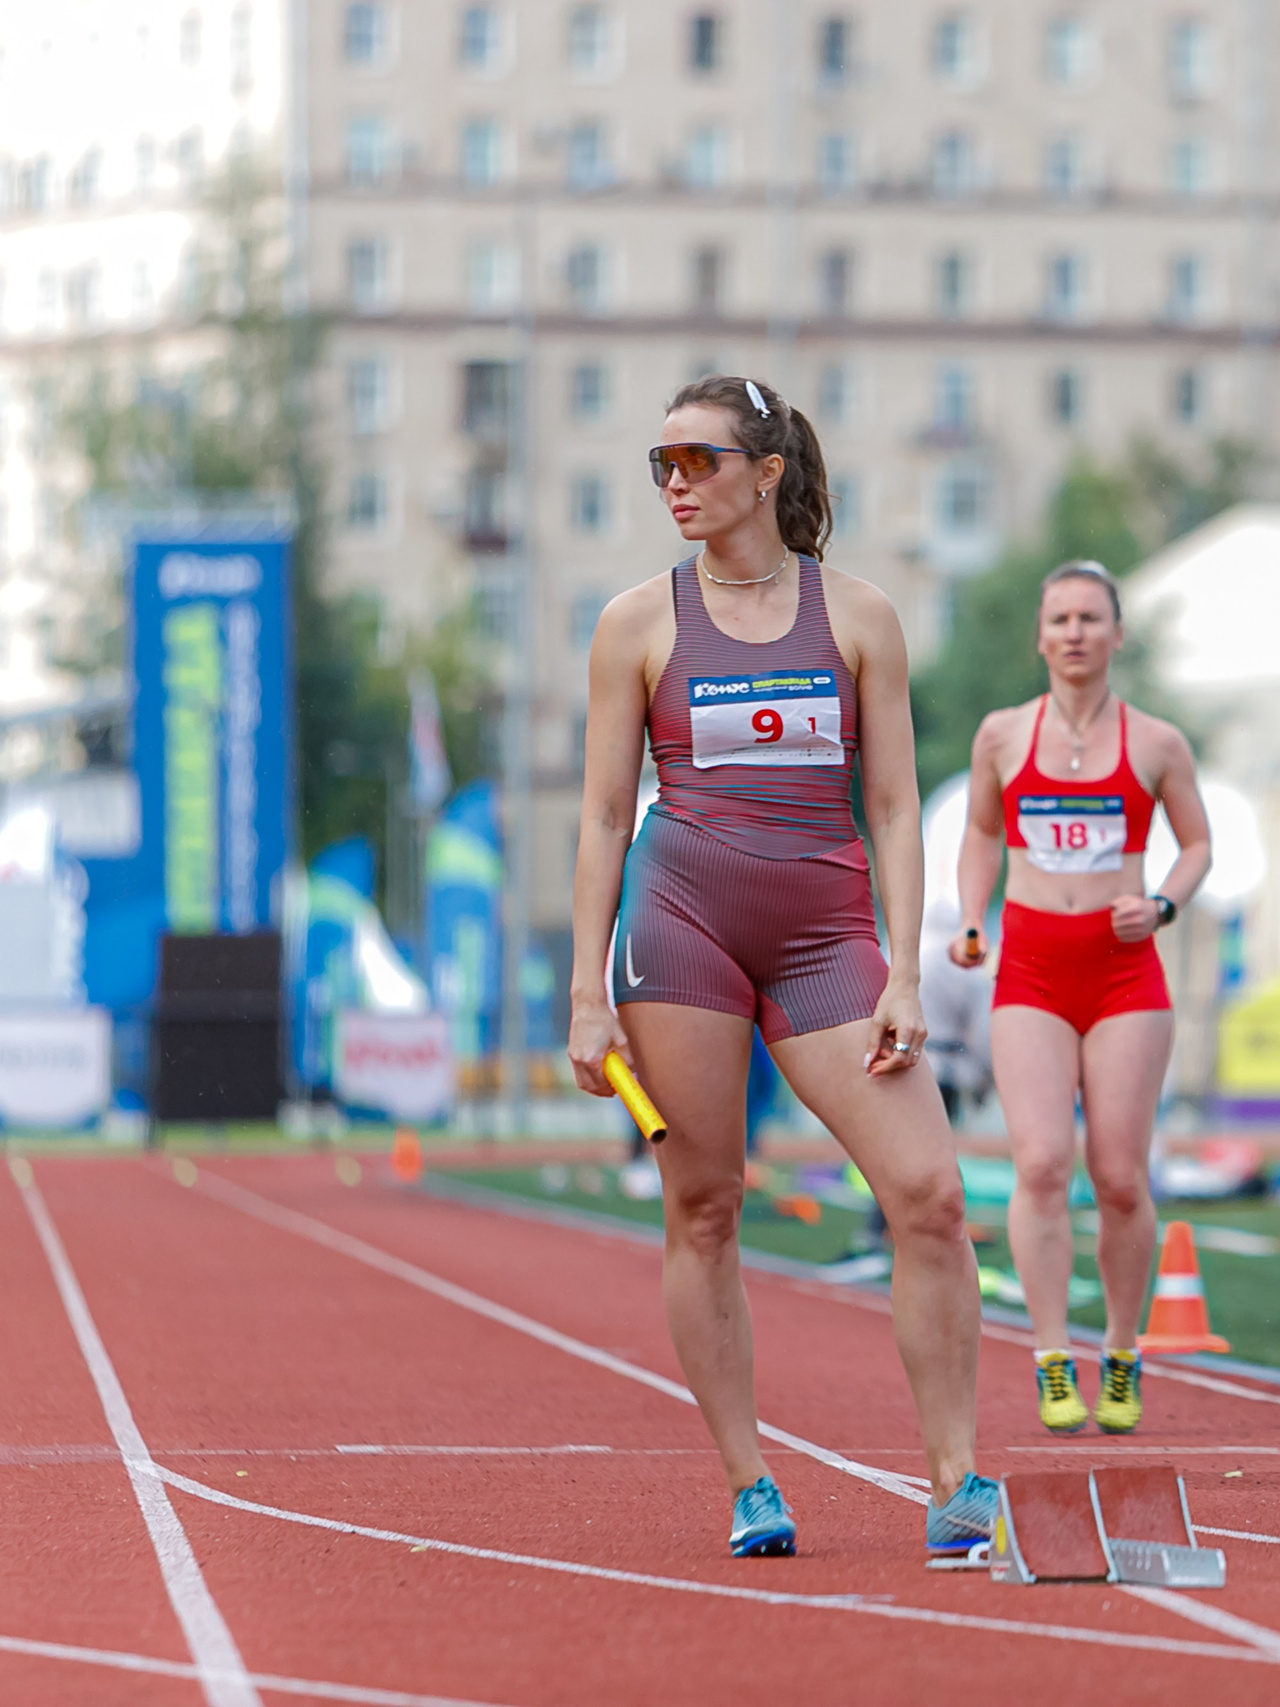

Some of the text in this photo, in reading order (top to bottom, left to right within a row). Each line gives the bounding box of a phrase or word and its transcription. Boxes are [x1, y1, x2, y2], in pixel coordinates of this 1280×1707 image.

[751, 708, 784, 744] 9
[807, 716, 816, 734] 1
[1050, 822, 1088, 850] 18
